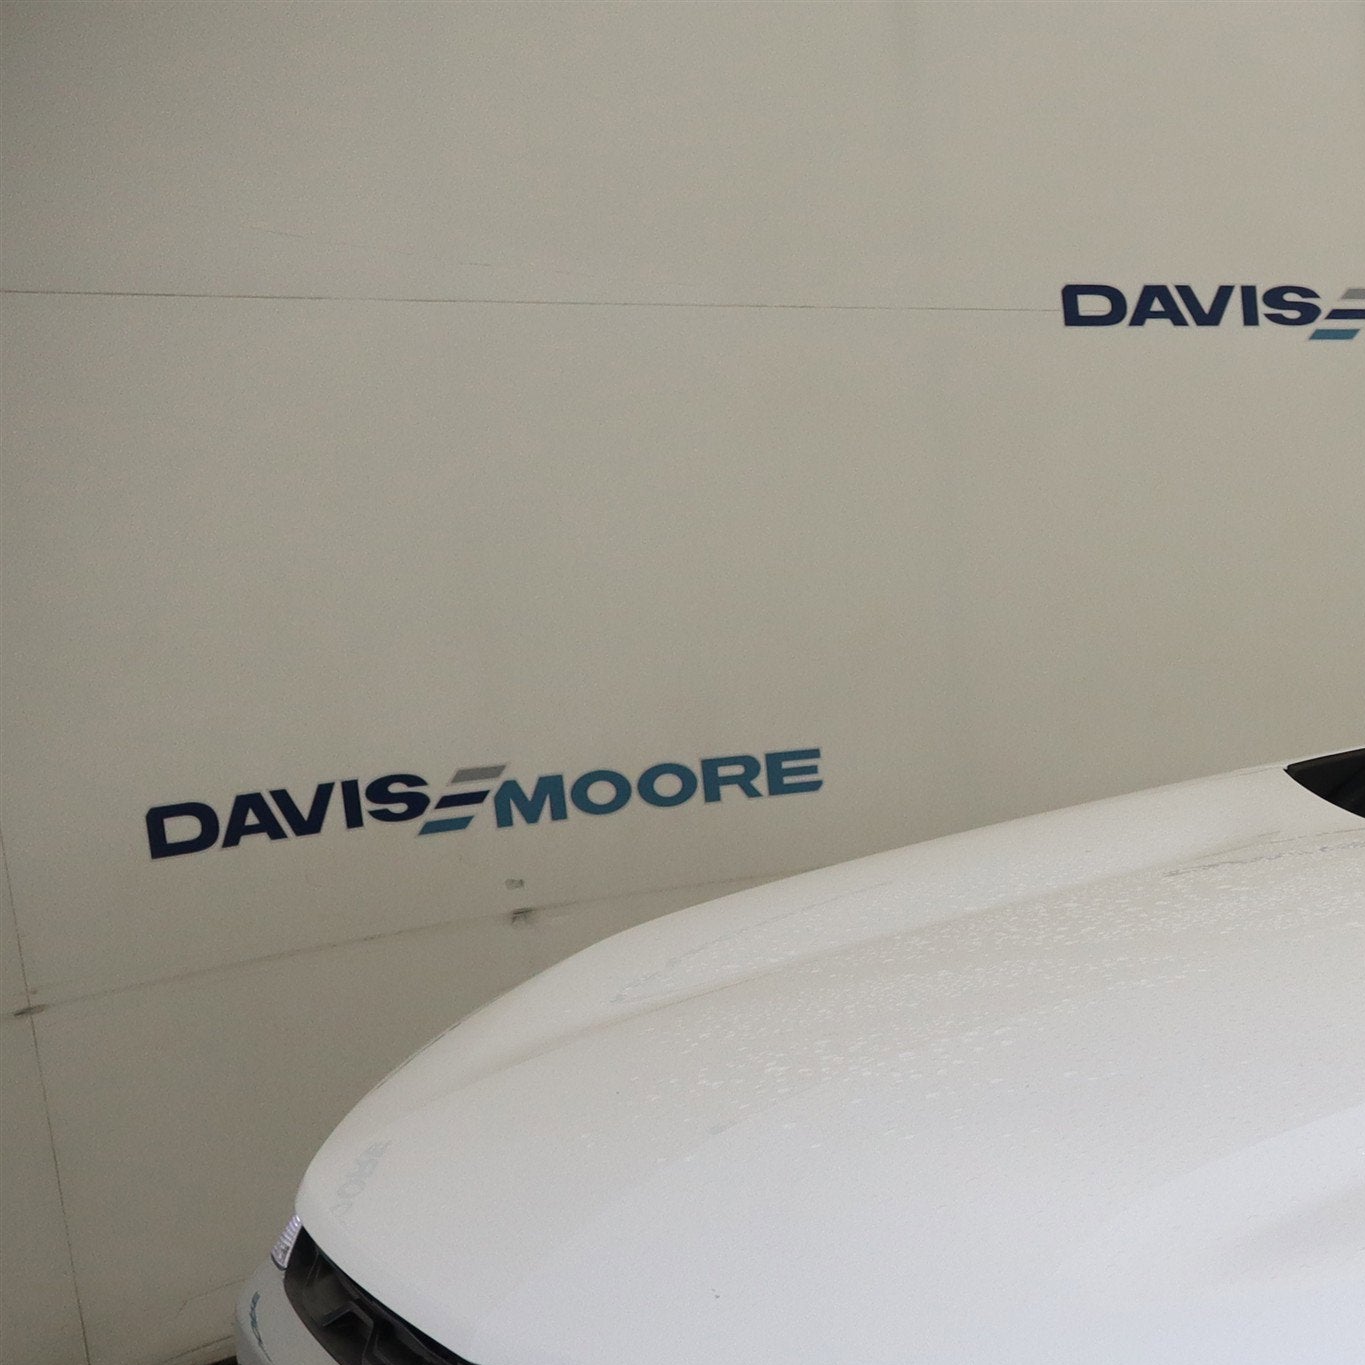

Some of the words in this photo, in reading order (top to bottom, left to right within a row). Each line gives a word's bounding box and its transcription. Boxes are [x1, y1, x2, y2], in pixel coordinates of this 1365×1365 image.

[1061, 284, 1322, 327] DAVIS
[145, 773, 431, 860] DAVIS
[496, 748, 824, 829] MOORE
